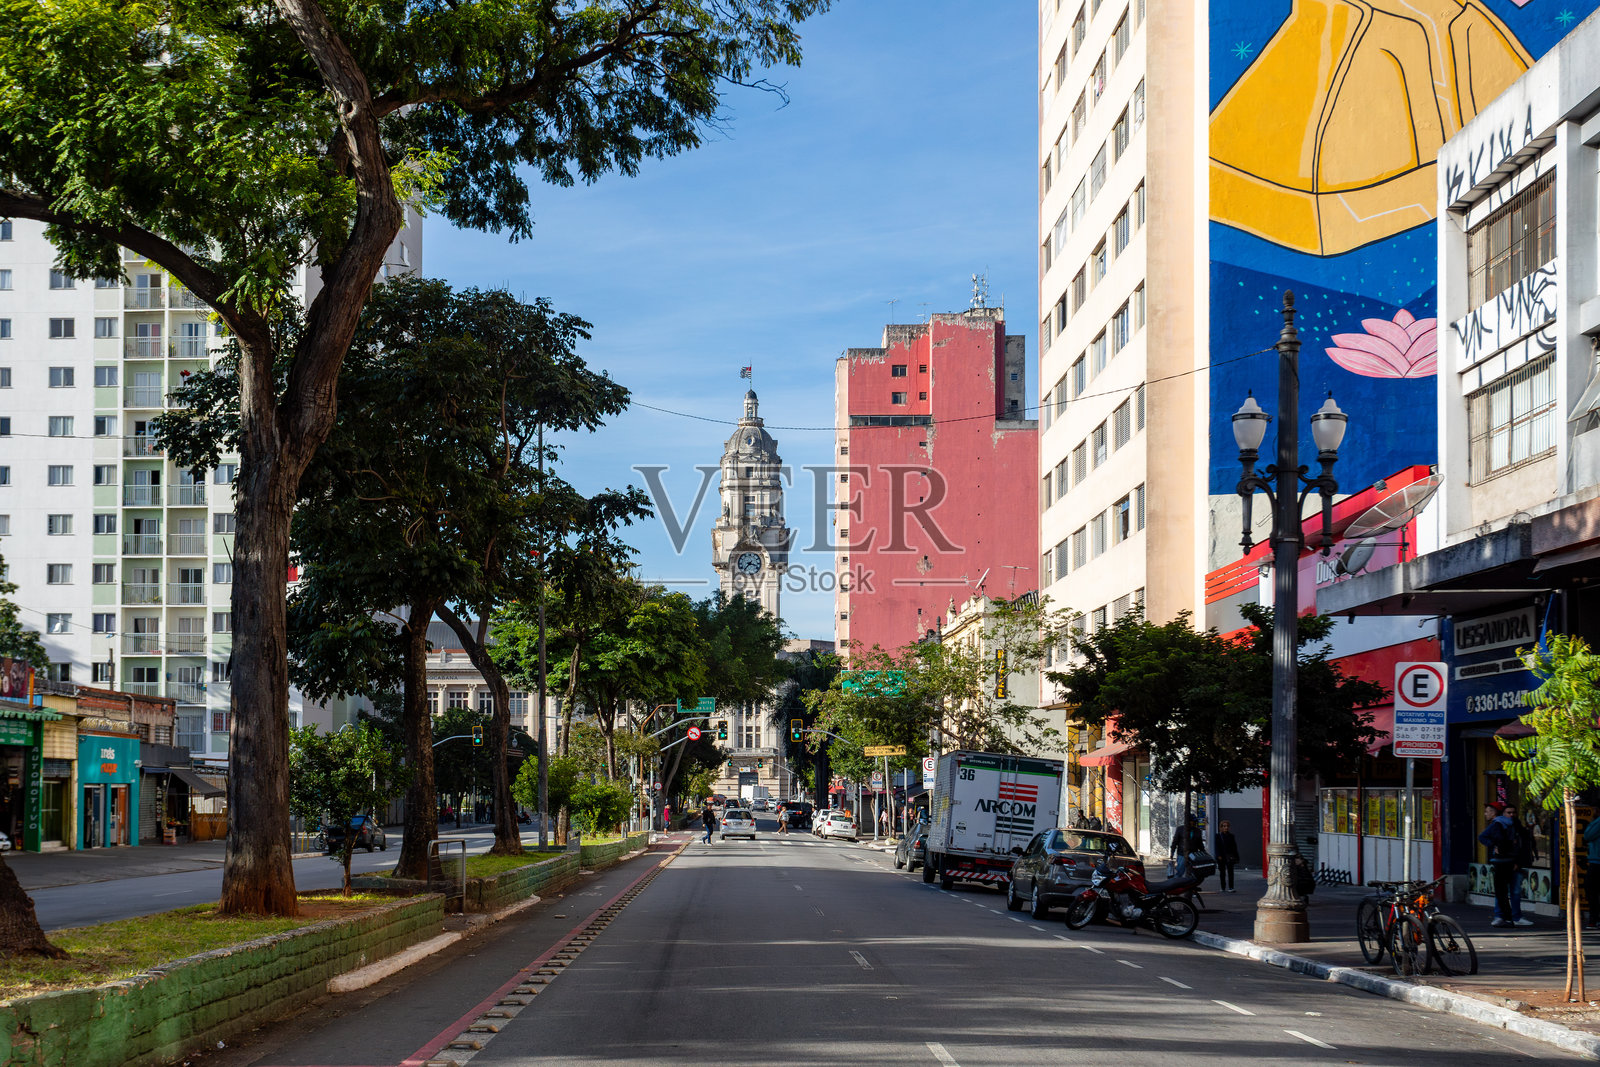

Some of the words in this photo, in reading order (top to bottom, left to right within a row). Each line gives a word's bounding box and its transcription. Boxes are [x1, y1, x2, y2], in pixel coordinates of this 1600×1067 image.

[1412, 674, 1429, 698] E
[1474, 689, 1529, 713] 3361-6347
[927, 760, 933, 769] E
[960, 768, 976, 781] 36
[29, 746, 39, 830] AUTOMOTIVO
[974, 798, 1037, 818] ARCOM
